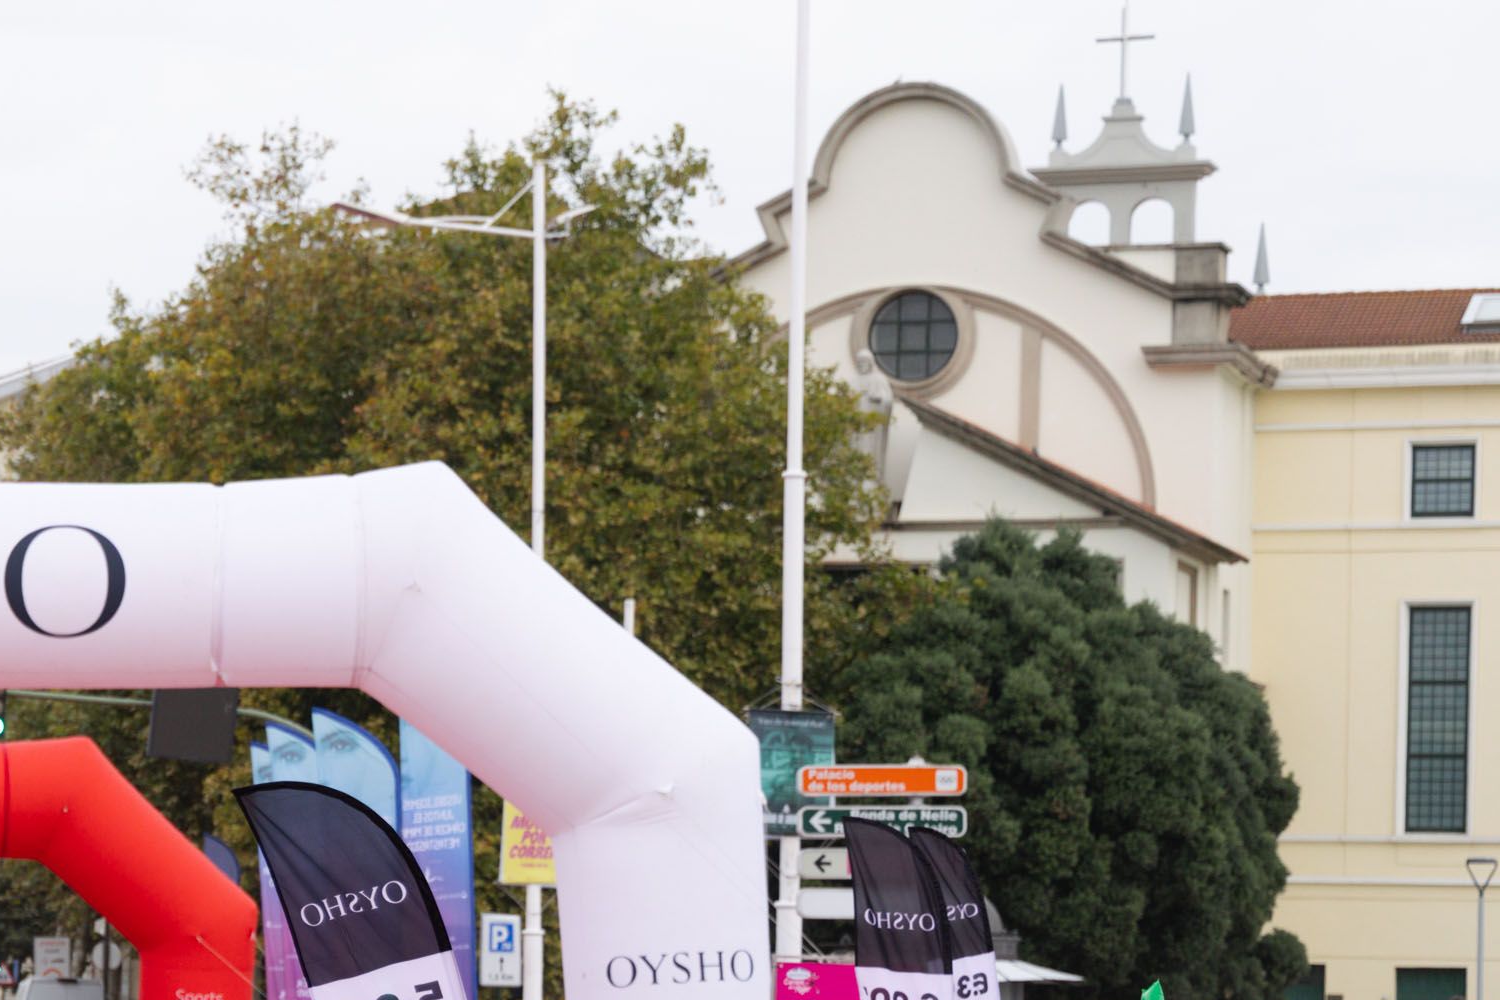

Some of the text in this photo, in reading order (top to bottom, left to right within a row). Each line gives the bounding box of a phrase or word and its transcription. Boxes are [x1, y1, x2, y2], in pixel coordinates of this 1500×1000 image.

[808, 769, 855, 781] Palacio
[808, 781, 906, 794] de los deportes
[898, 809, 917, 821] de
[920, 809, 958, 821] Nelle
[606, 949, 754, 989] OYSHO
